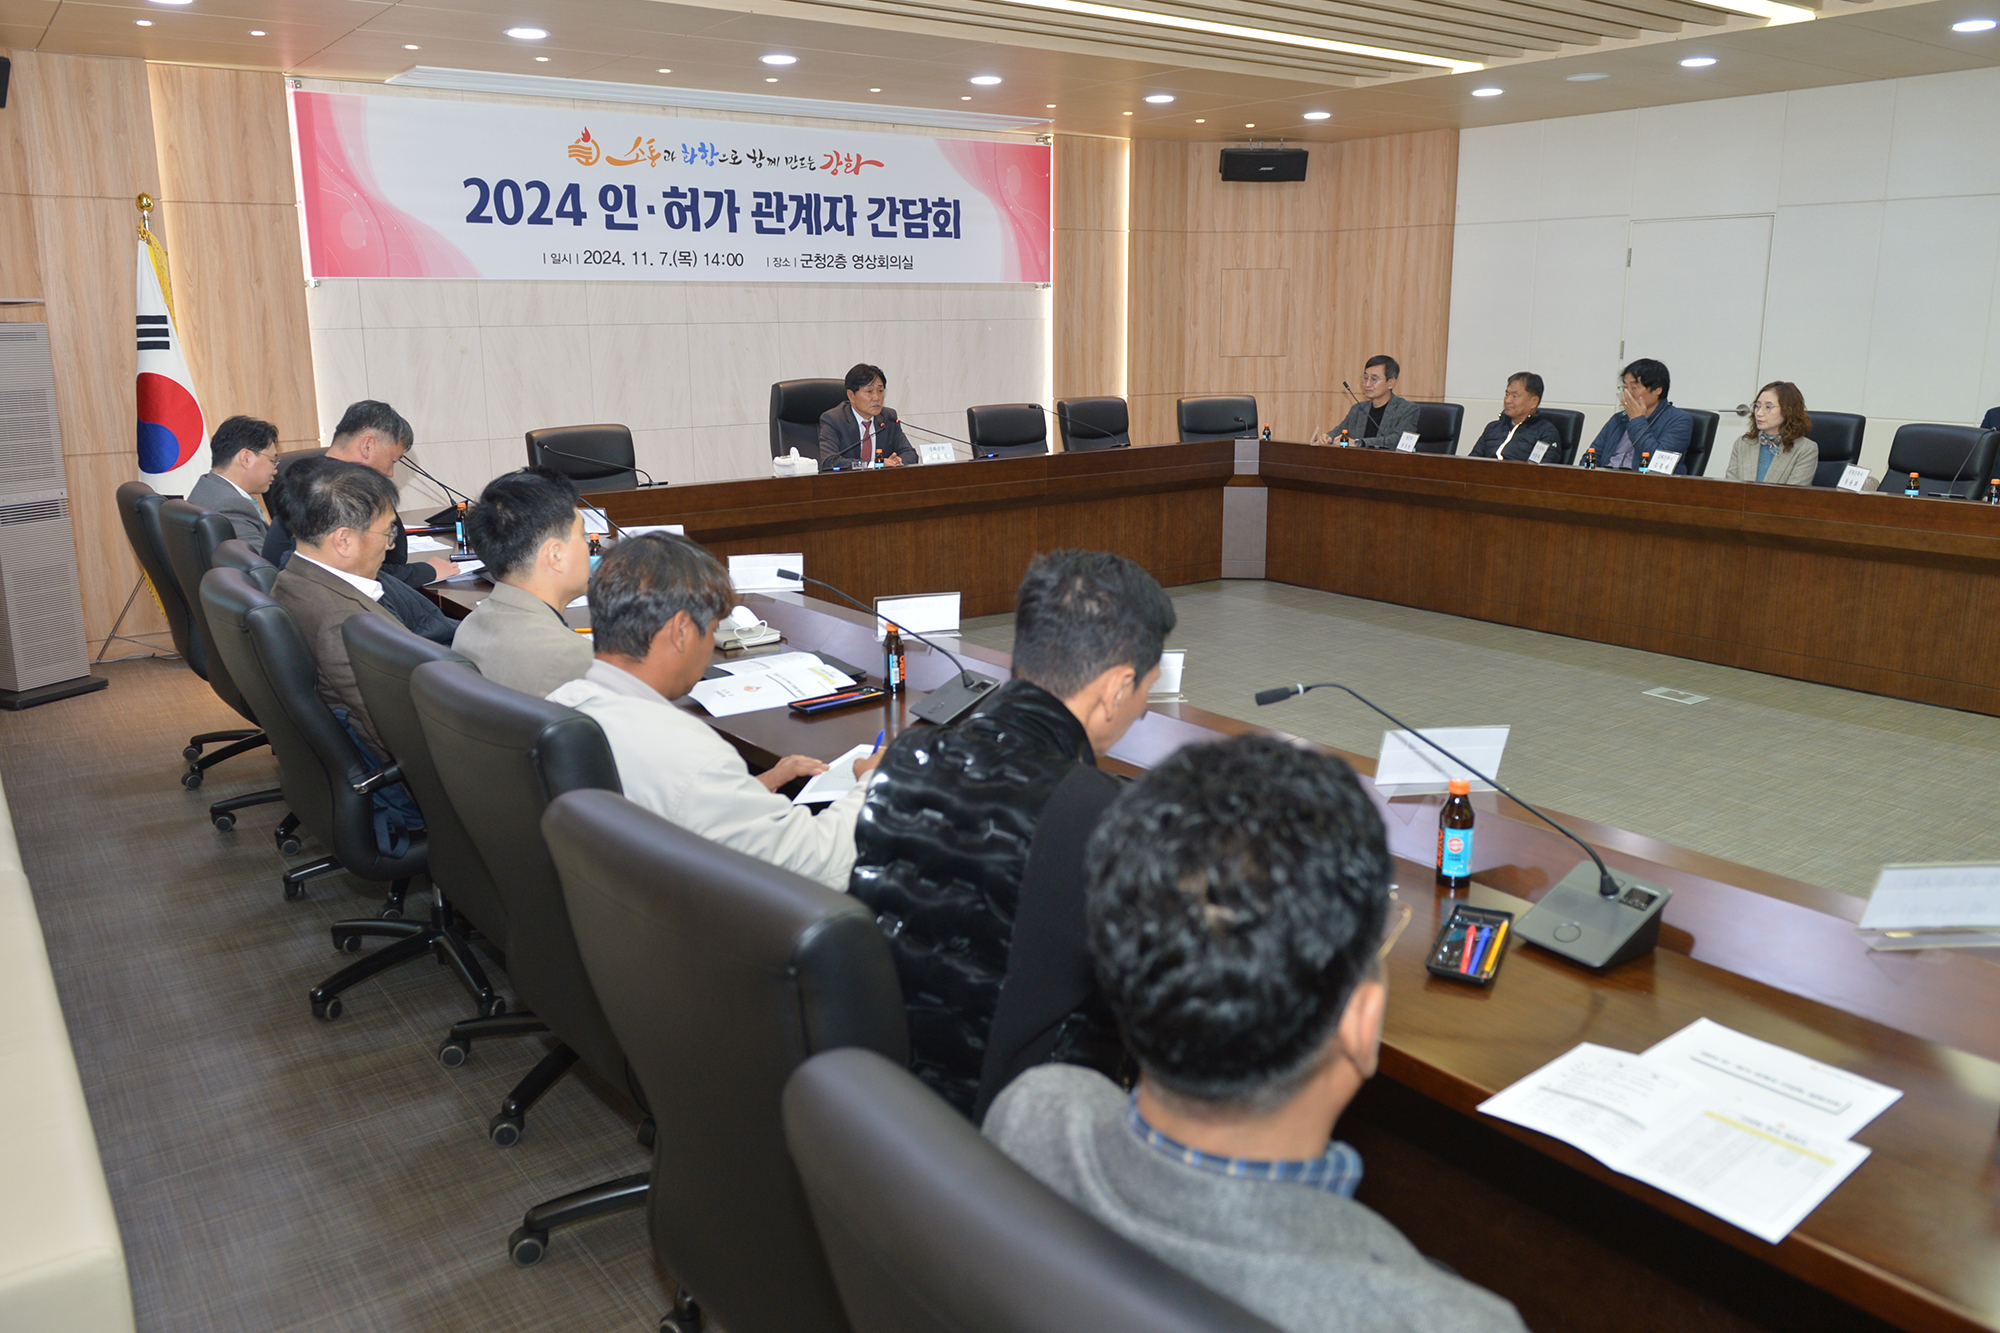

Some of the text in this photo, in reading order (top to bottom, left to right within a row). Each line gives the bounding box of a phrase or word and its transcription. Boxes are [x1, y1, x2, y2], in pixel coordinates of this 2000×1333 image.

[605, 136, 885, 176] 소통과 화합으로 함께 만드는 강화
[463, 177, 961, 240] 2024 인·허가 관계자 간담회
[583, 250, 626, 266] 2024.
[632, 251, 654, 267] 11.
[659, 250, 698, 268] 7.(목)
[703, 252, 744, 267] 14:00
[800, 254, 848, 270] 군청2층
[851, 254, 914, 271] 영상회의실
